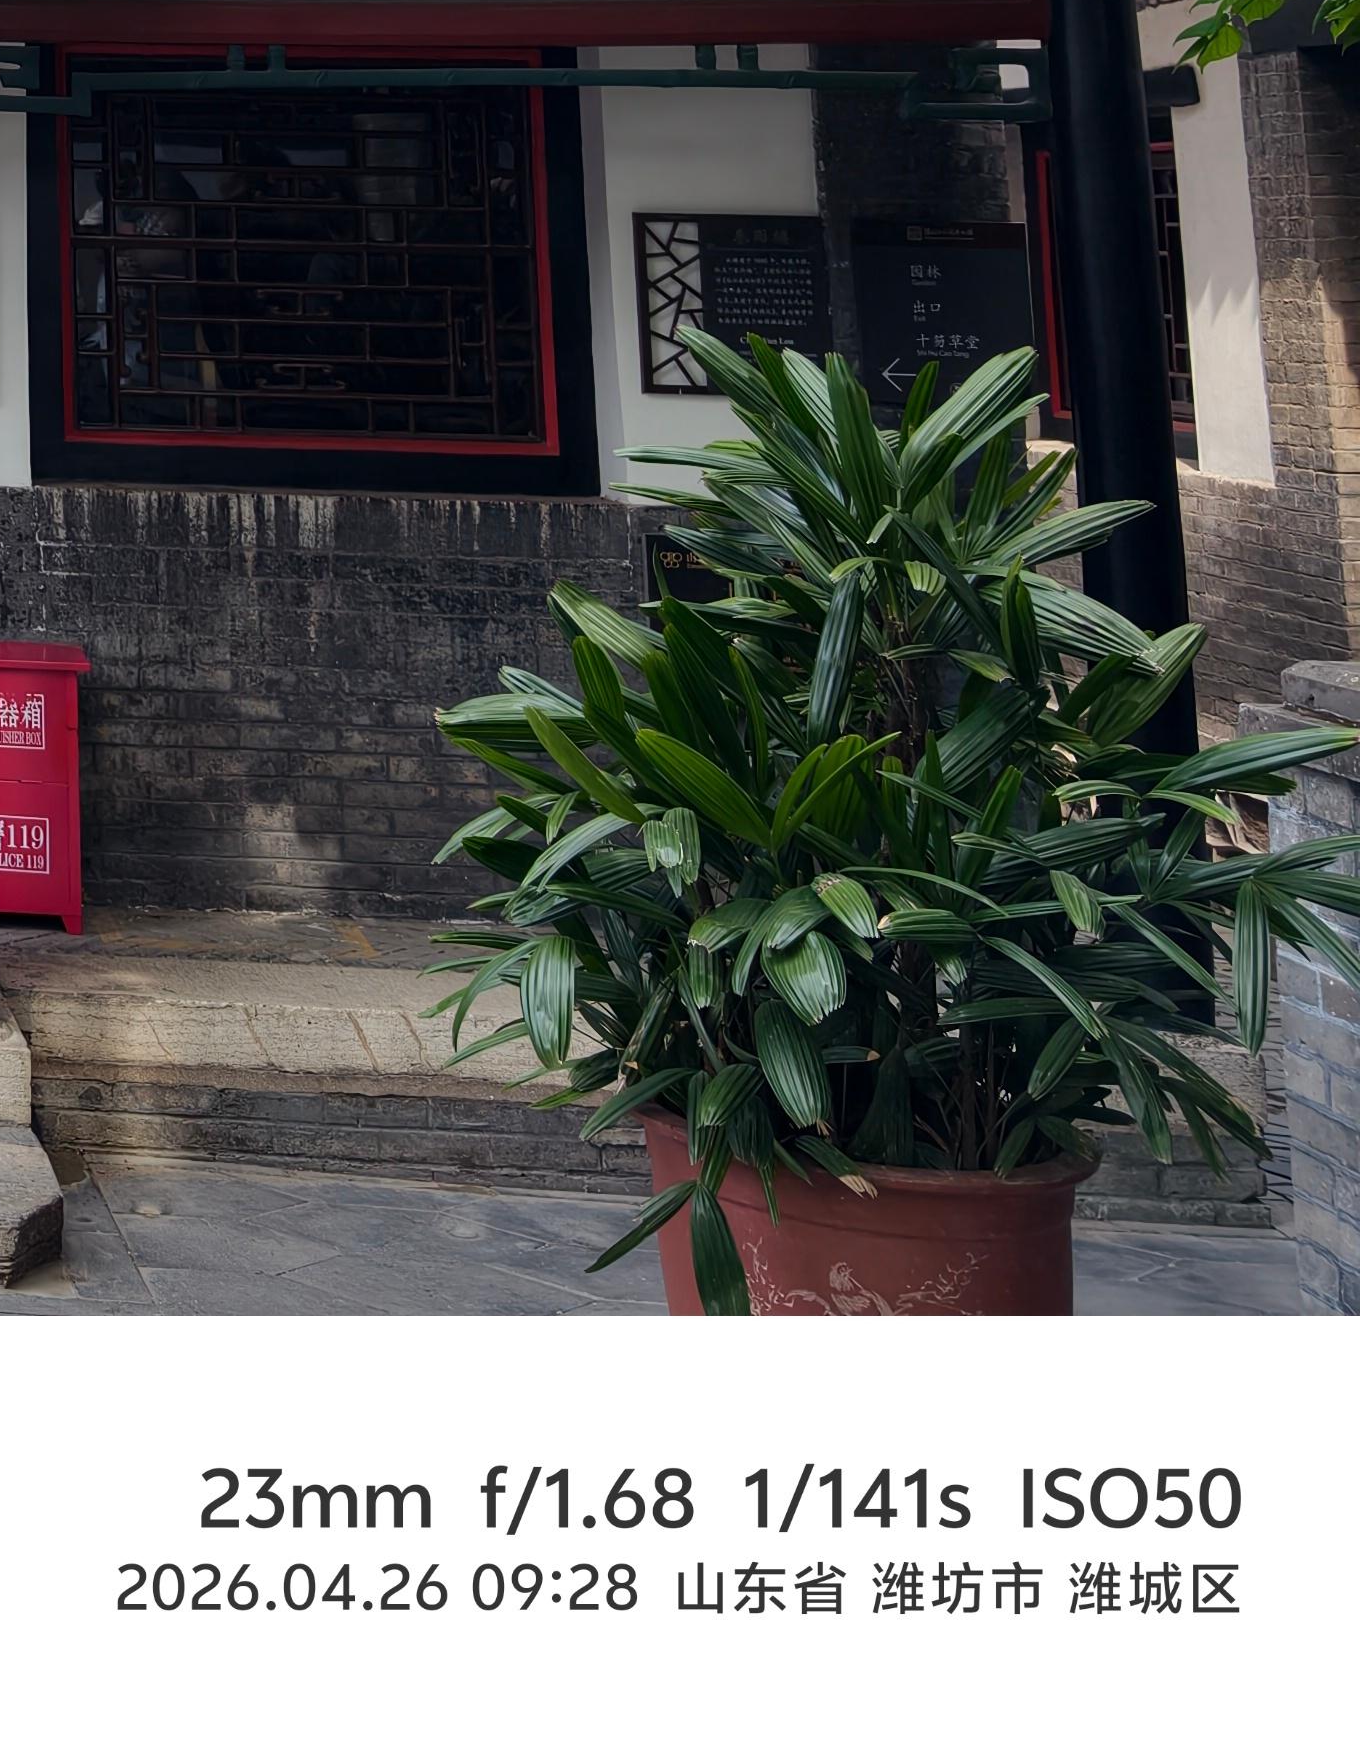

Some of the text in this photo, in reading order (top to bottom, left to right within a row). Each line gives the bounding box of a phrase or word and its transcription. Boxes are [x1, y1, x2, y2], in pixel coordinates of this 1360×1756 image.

[910, 264, 942, 279] 园林
[913, 300, 941, 314] 出口
[25, 731, 42, 745] BOX
[26, 854, 45, 870] 119
